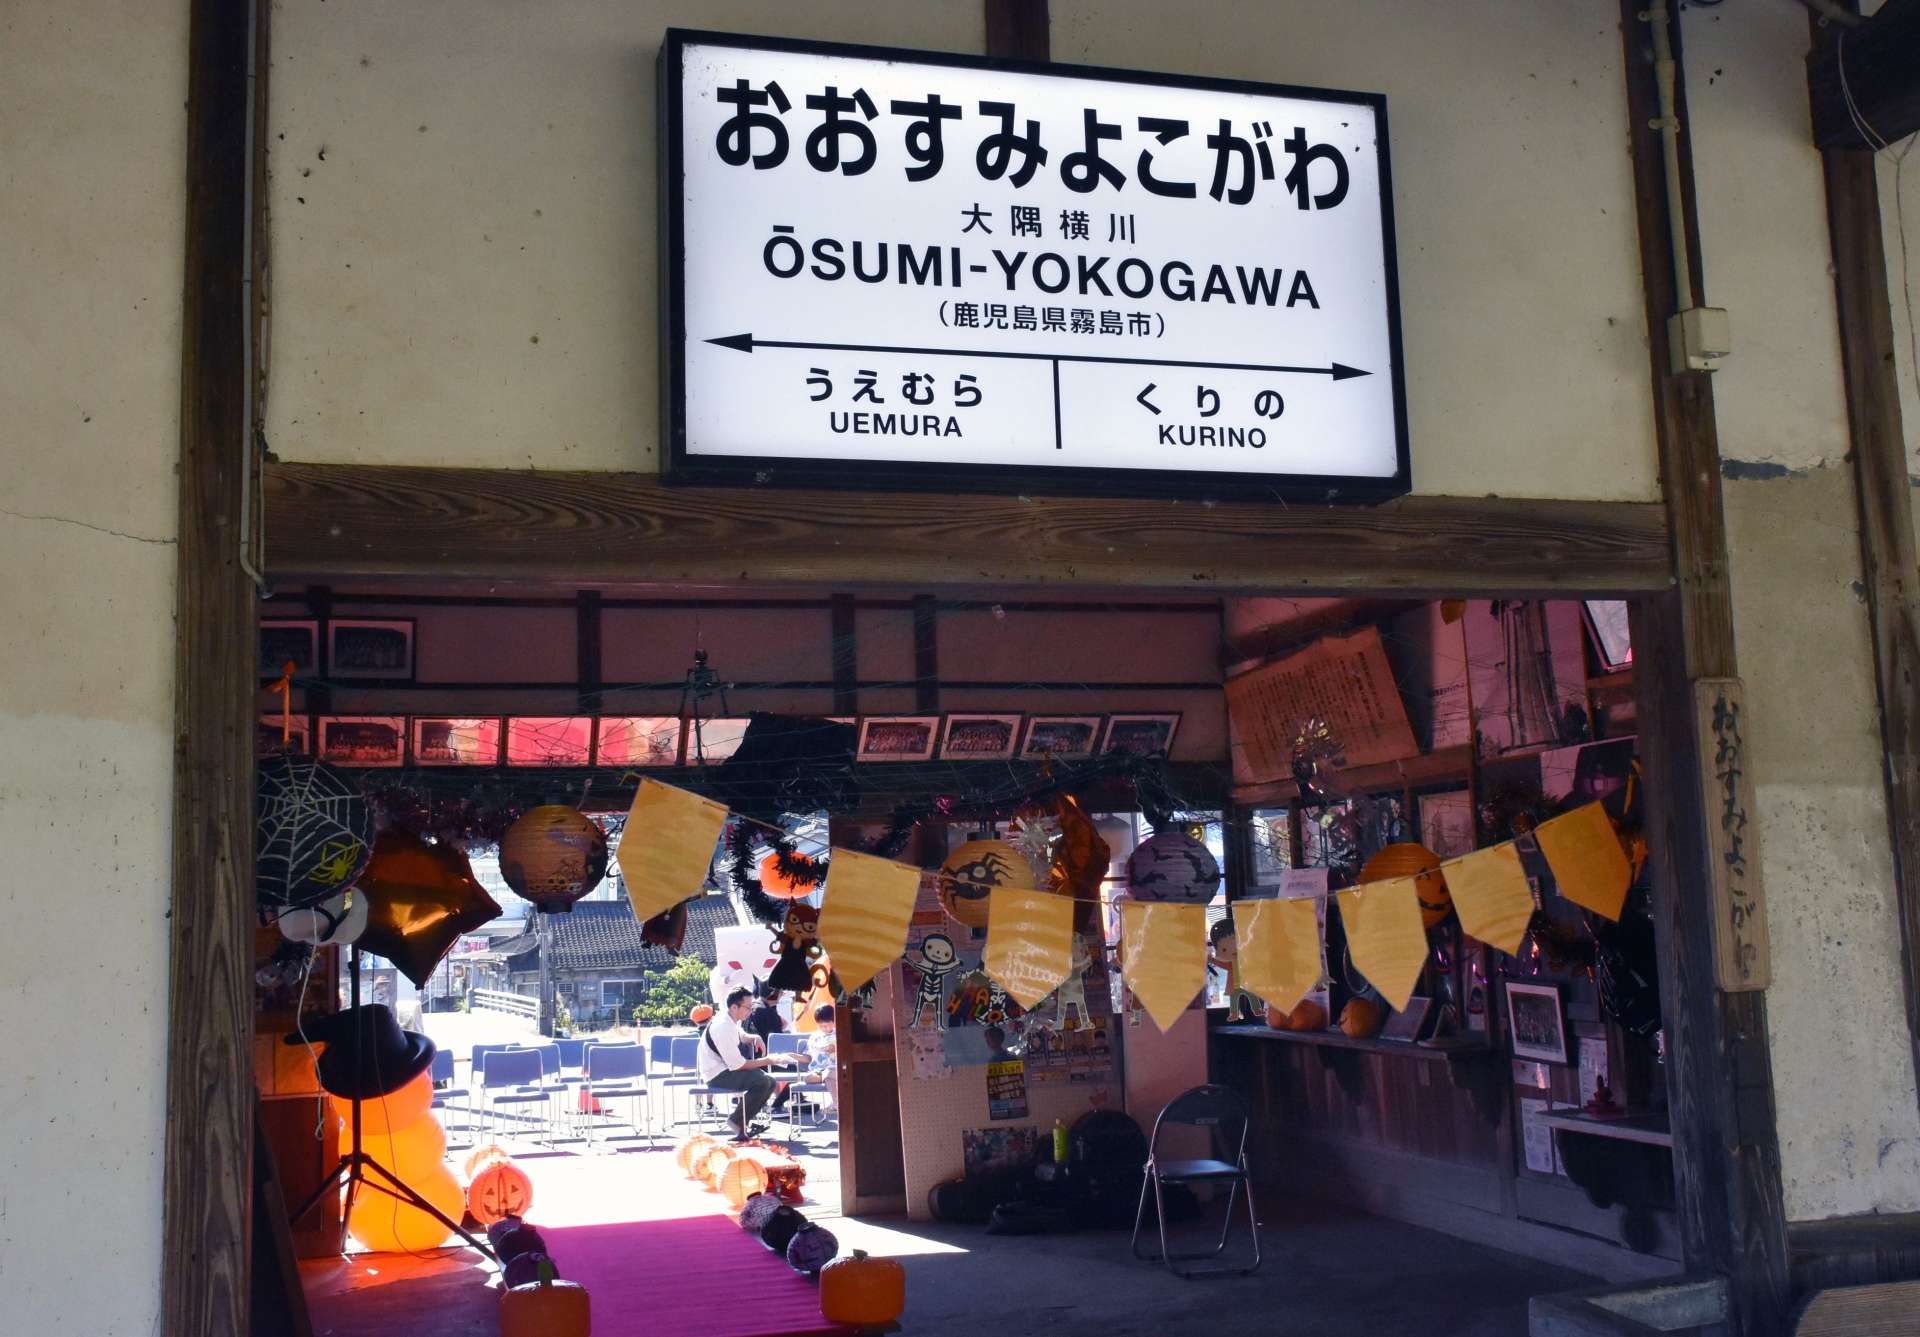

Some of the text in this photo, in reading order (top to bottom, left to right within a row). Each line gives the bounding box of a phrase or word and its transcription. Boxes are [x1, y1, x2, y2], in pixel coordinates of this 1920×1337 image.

[716, 78, 1350, 210] おおすみよこがわ
[961, 202, 1136, 244] 大隅横川
[763, 225, 1321, 310] ŌSUMI-YOKOGAWA
[805, 367, 983, 408] うえむら
[1136, 382, 1285, 420] くりの
[830, 411, 963, 438] UEMURA
[1158, 424, 1267, 449] KURINO
